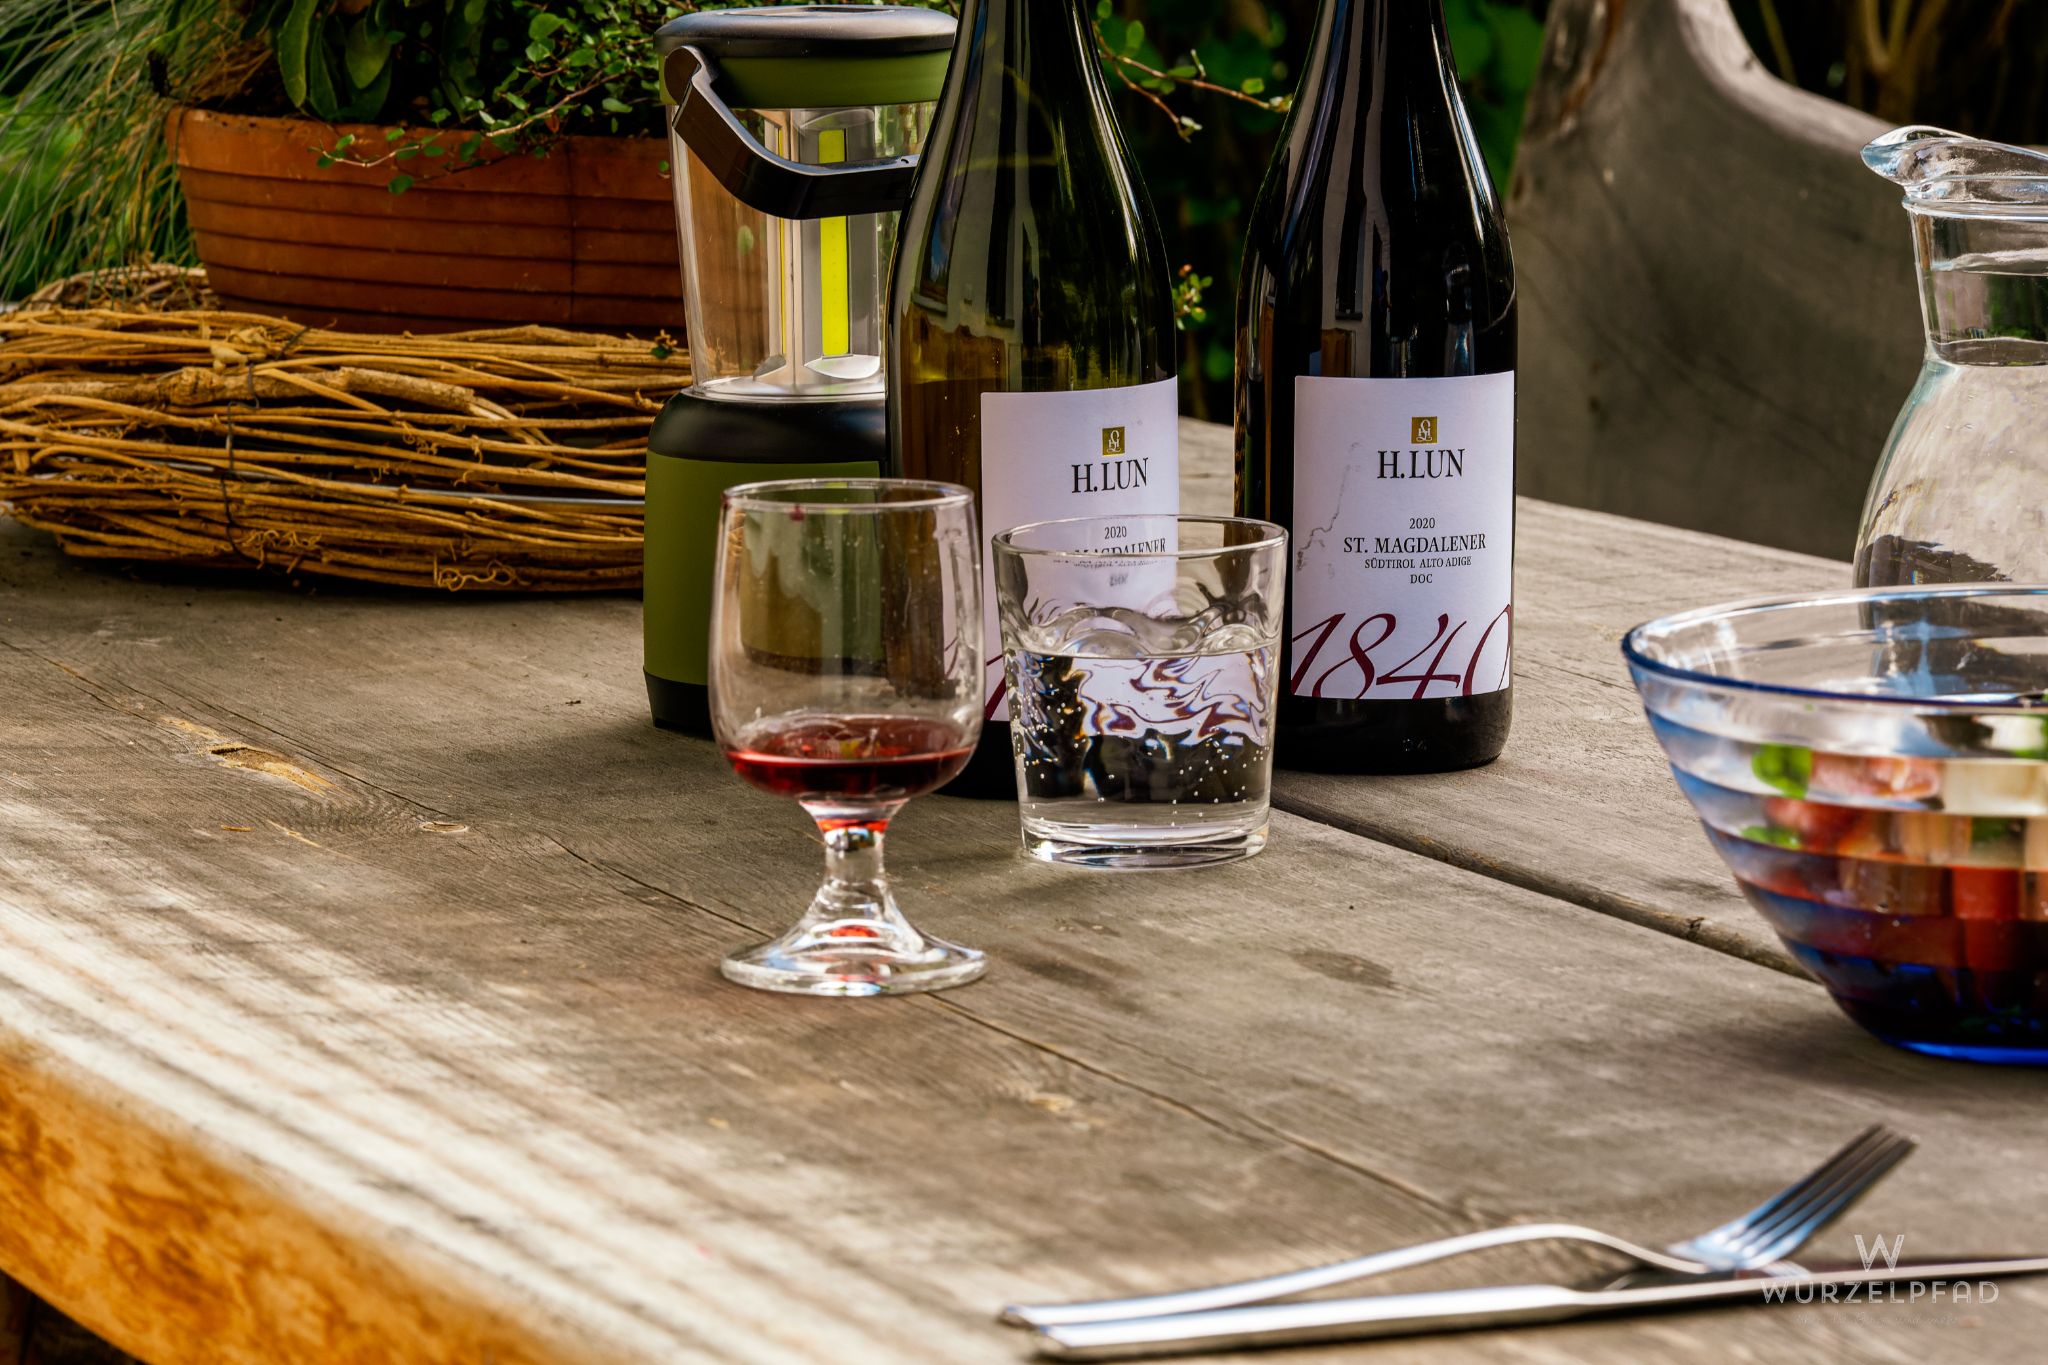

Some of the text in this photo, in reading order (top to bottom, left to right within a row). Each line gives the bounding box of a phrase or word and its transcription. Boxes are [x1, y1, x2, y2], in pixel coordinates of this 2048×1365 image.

[1409, 518, 1436, 529] 2020
[1104, 526, 1127, 539] 2020
[1344, 534, 1486, 554] ST. MAGDALENER
[1365, 556, 1472, 569] SÜDTIROL ALTO ADIGE
[1410, 574, 1432, 584] DOC
